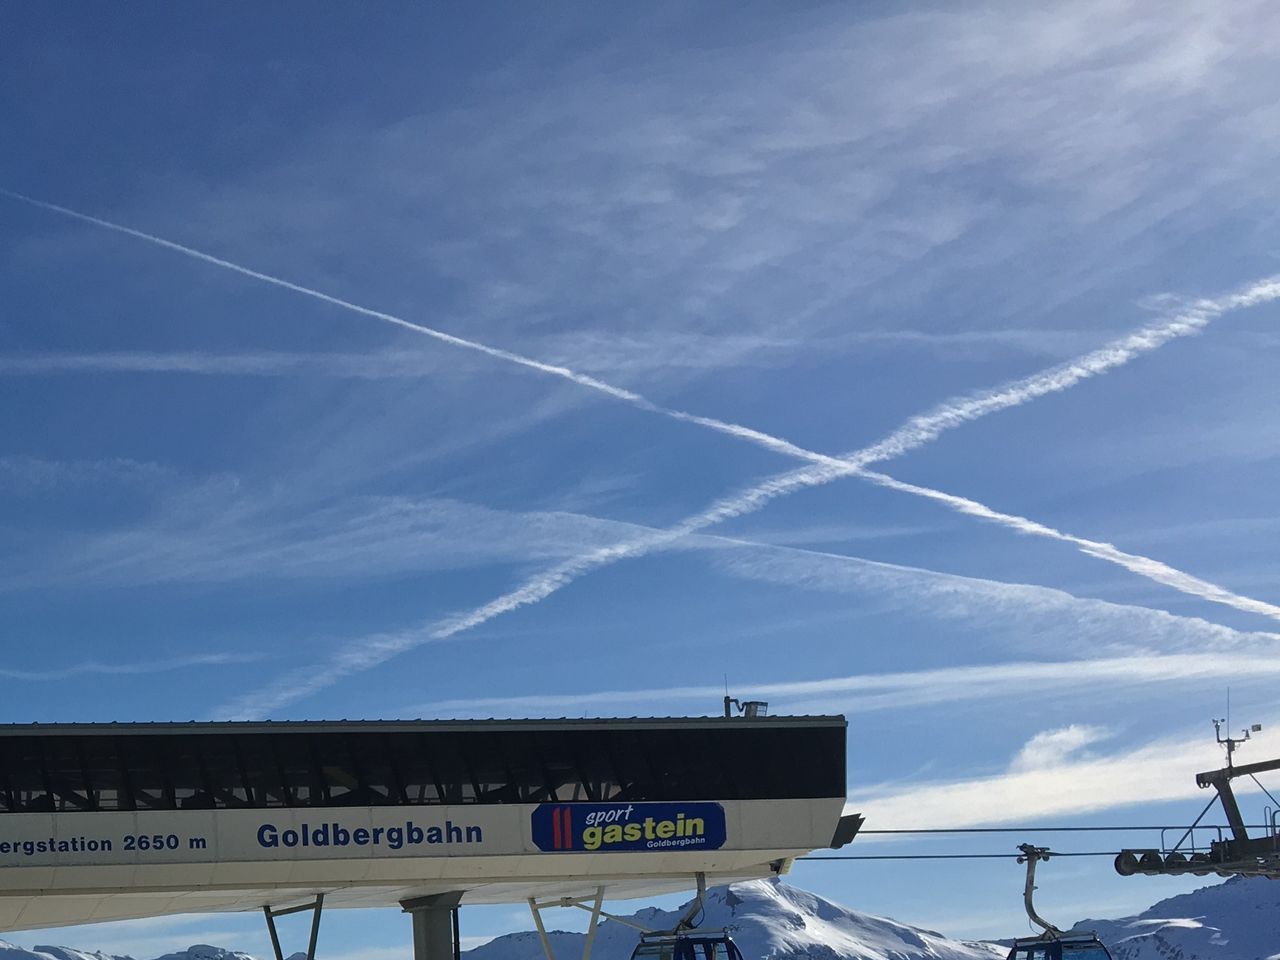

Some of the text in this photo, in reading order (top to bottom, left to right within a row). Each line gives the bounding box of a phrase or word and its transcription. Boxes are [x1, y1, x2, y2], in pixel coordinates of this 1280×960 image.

[585, 805, 634, 827] sport
[123, 834, 180, 851] 2650
[189, 836, 208, 850] m
[256, 820, 483, 849] Goldbergbahn
[583, 813, 705, 850] gastein
[647, 837, 706, 849] Goldbergbahn
